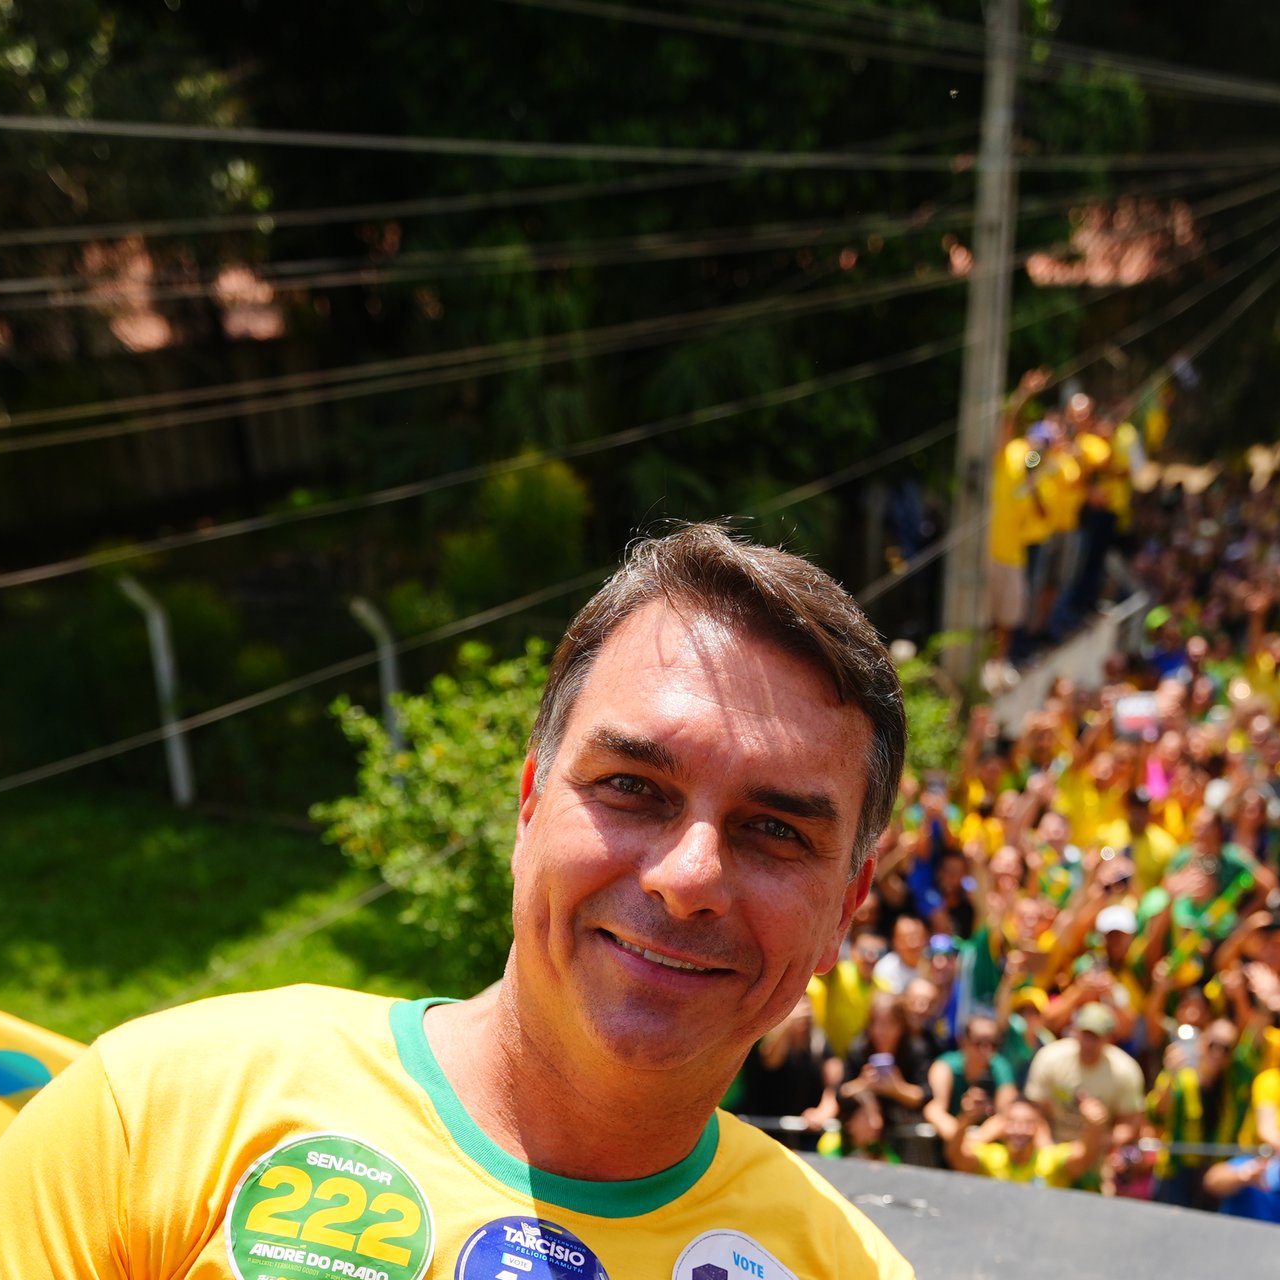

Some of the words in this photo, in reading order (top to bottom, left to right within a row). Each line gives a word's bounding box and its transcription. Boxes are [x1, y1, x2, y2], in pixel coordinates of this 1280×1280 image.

[306, 1152, 392, 1186] SENADOR
[245, 1165, 421, 1267] 222
[249, 1243, 307, 1264] ANDRÉ
[306, 1253, 331, 1270] DO
[503, 1225, 585, 1266] TARCÍSIO
[509, 1257, 529, 1269] VOTE
[549, 1258, 583, 1274] RAMUTH
[732, 1251, 765, 1279] VOTE
